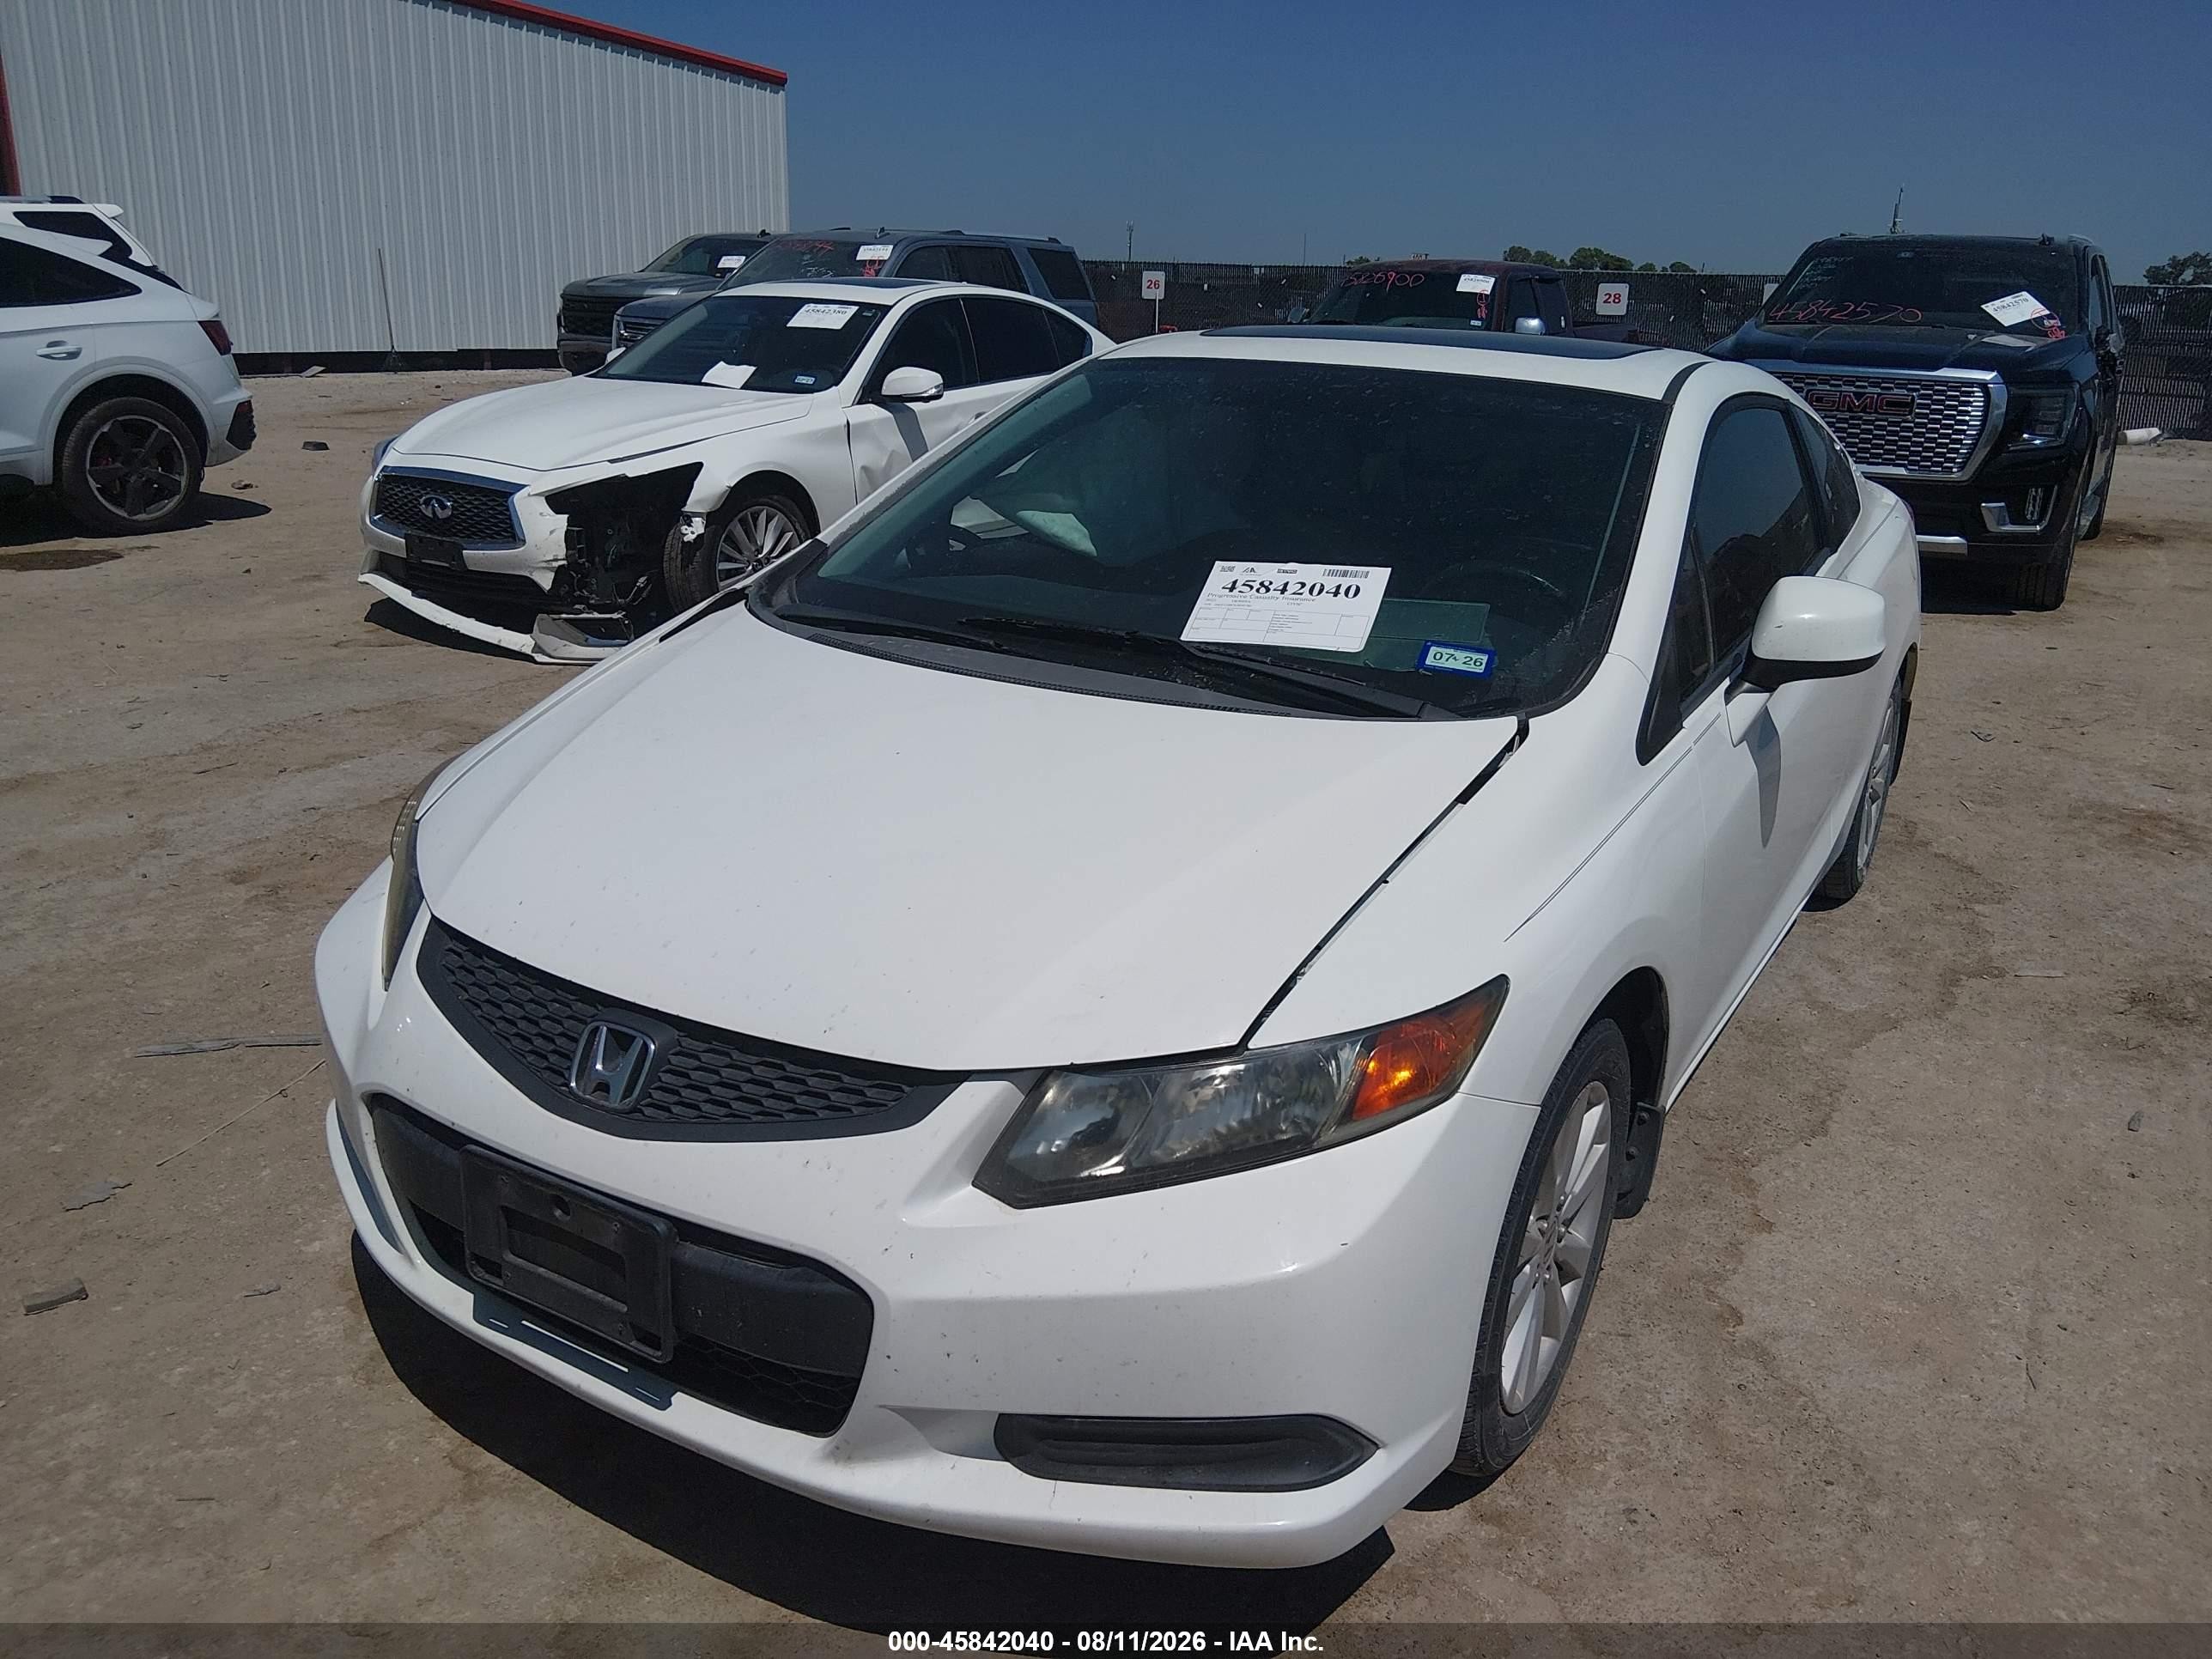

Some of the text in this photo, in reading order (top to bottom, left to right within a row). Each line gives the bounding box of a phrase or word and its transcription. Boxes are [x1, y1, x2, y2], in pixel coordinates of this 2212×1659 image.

[1146, 279, 1160, 289] 26
[1602, 293, 1622, 304] 28
[1769, 300, 1923, 324] 45842570
[1808, 391, 1912, 413] GMC
[1221, 578, 1361, 599] 45842040
[1462, 656, 1484, 667] 26
